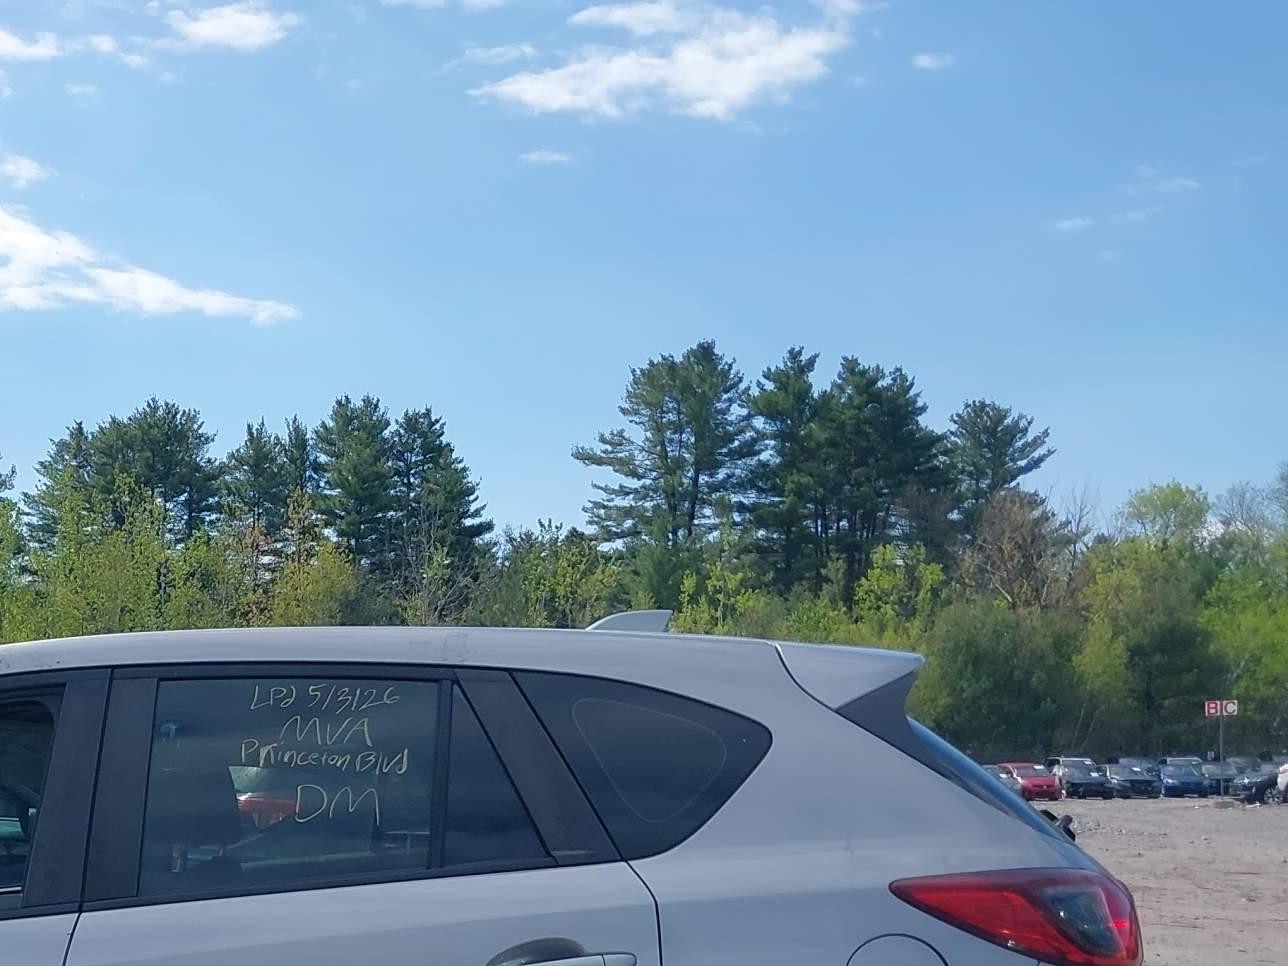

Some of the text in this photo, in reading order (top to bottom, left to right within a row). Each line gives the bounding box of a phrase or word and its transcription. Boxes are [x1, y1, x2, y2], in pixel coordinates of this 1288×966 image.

[1207, 700, 1218, 715] B
[1224, 701, 1237, 715] C
[279, 715, 373, 747] MVA
[355, 748, 409, 775] Blvd
[295, 784, 380, 826] DM
